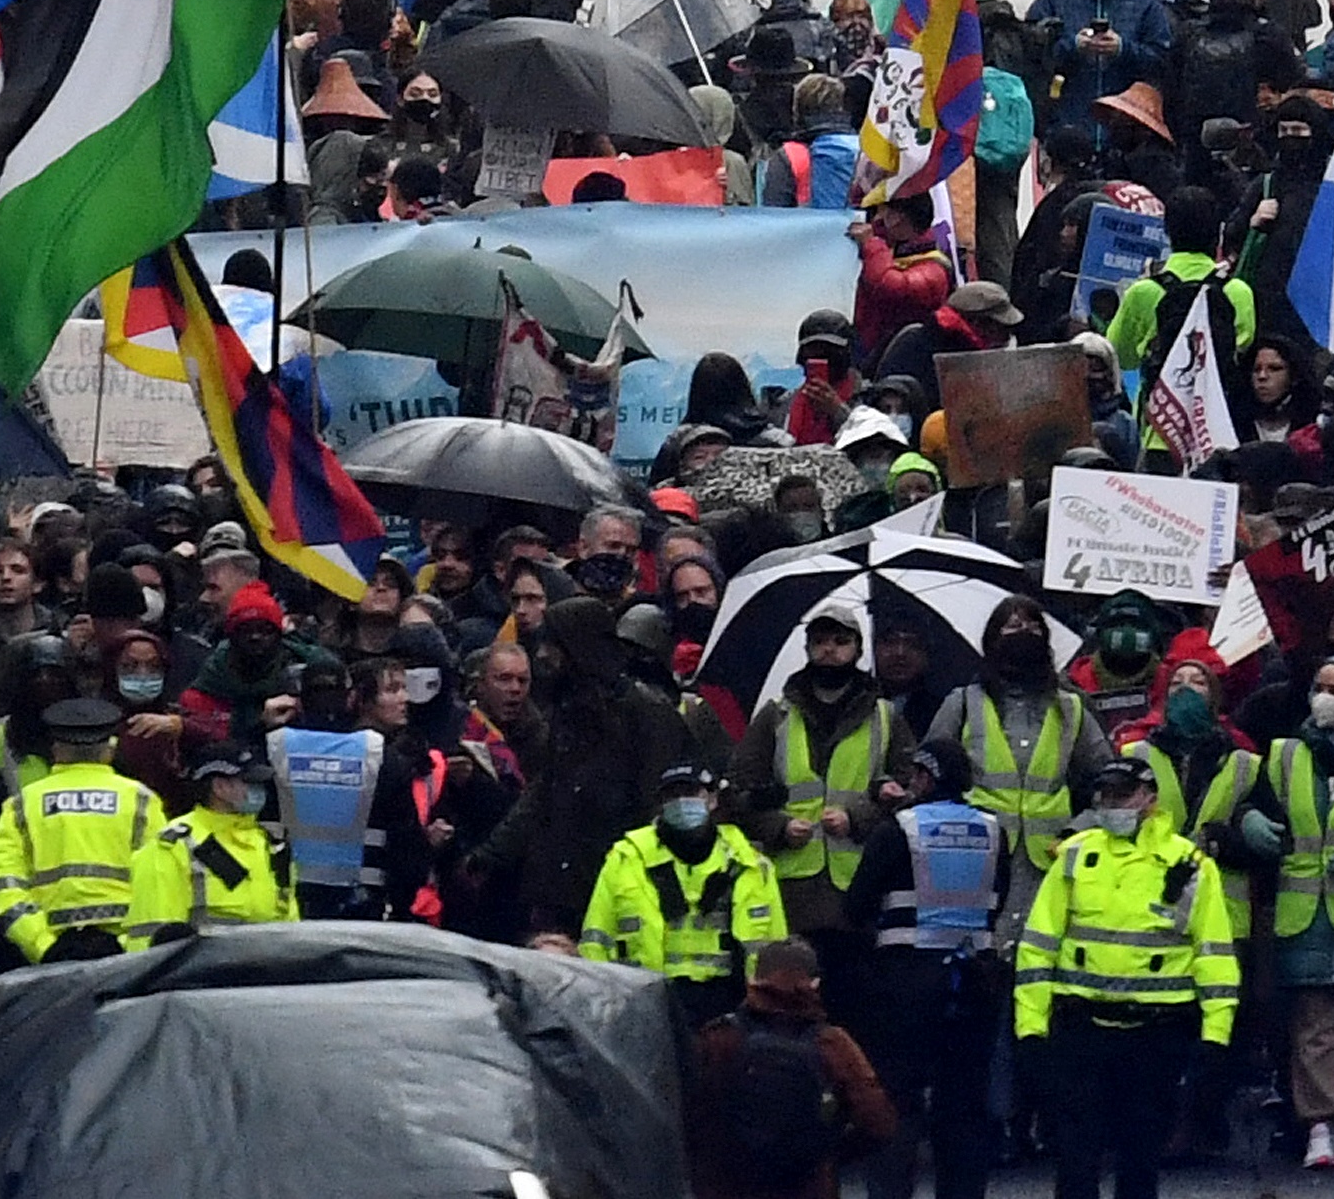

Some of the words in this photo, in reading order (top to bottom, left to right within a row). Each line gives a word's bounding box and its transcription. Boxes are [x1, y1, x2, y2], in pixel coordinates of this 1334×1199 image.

[1062, 551, 1092, 589] 4
[1096, 557, 1194, 588] AFRICA
[1301, 537, 1328, 584] 4
[45, 793, 116, 813] POLICE
